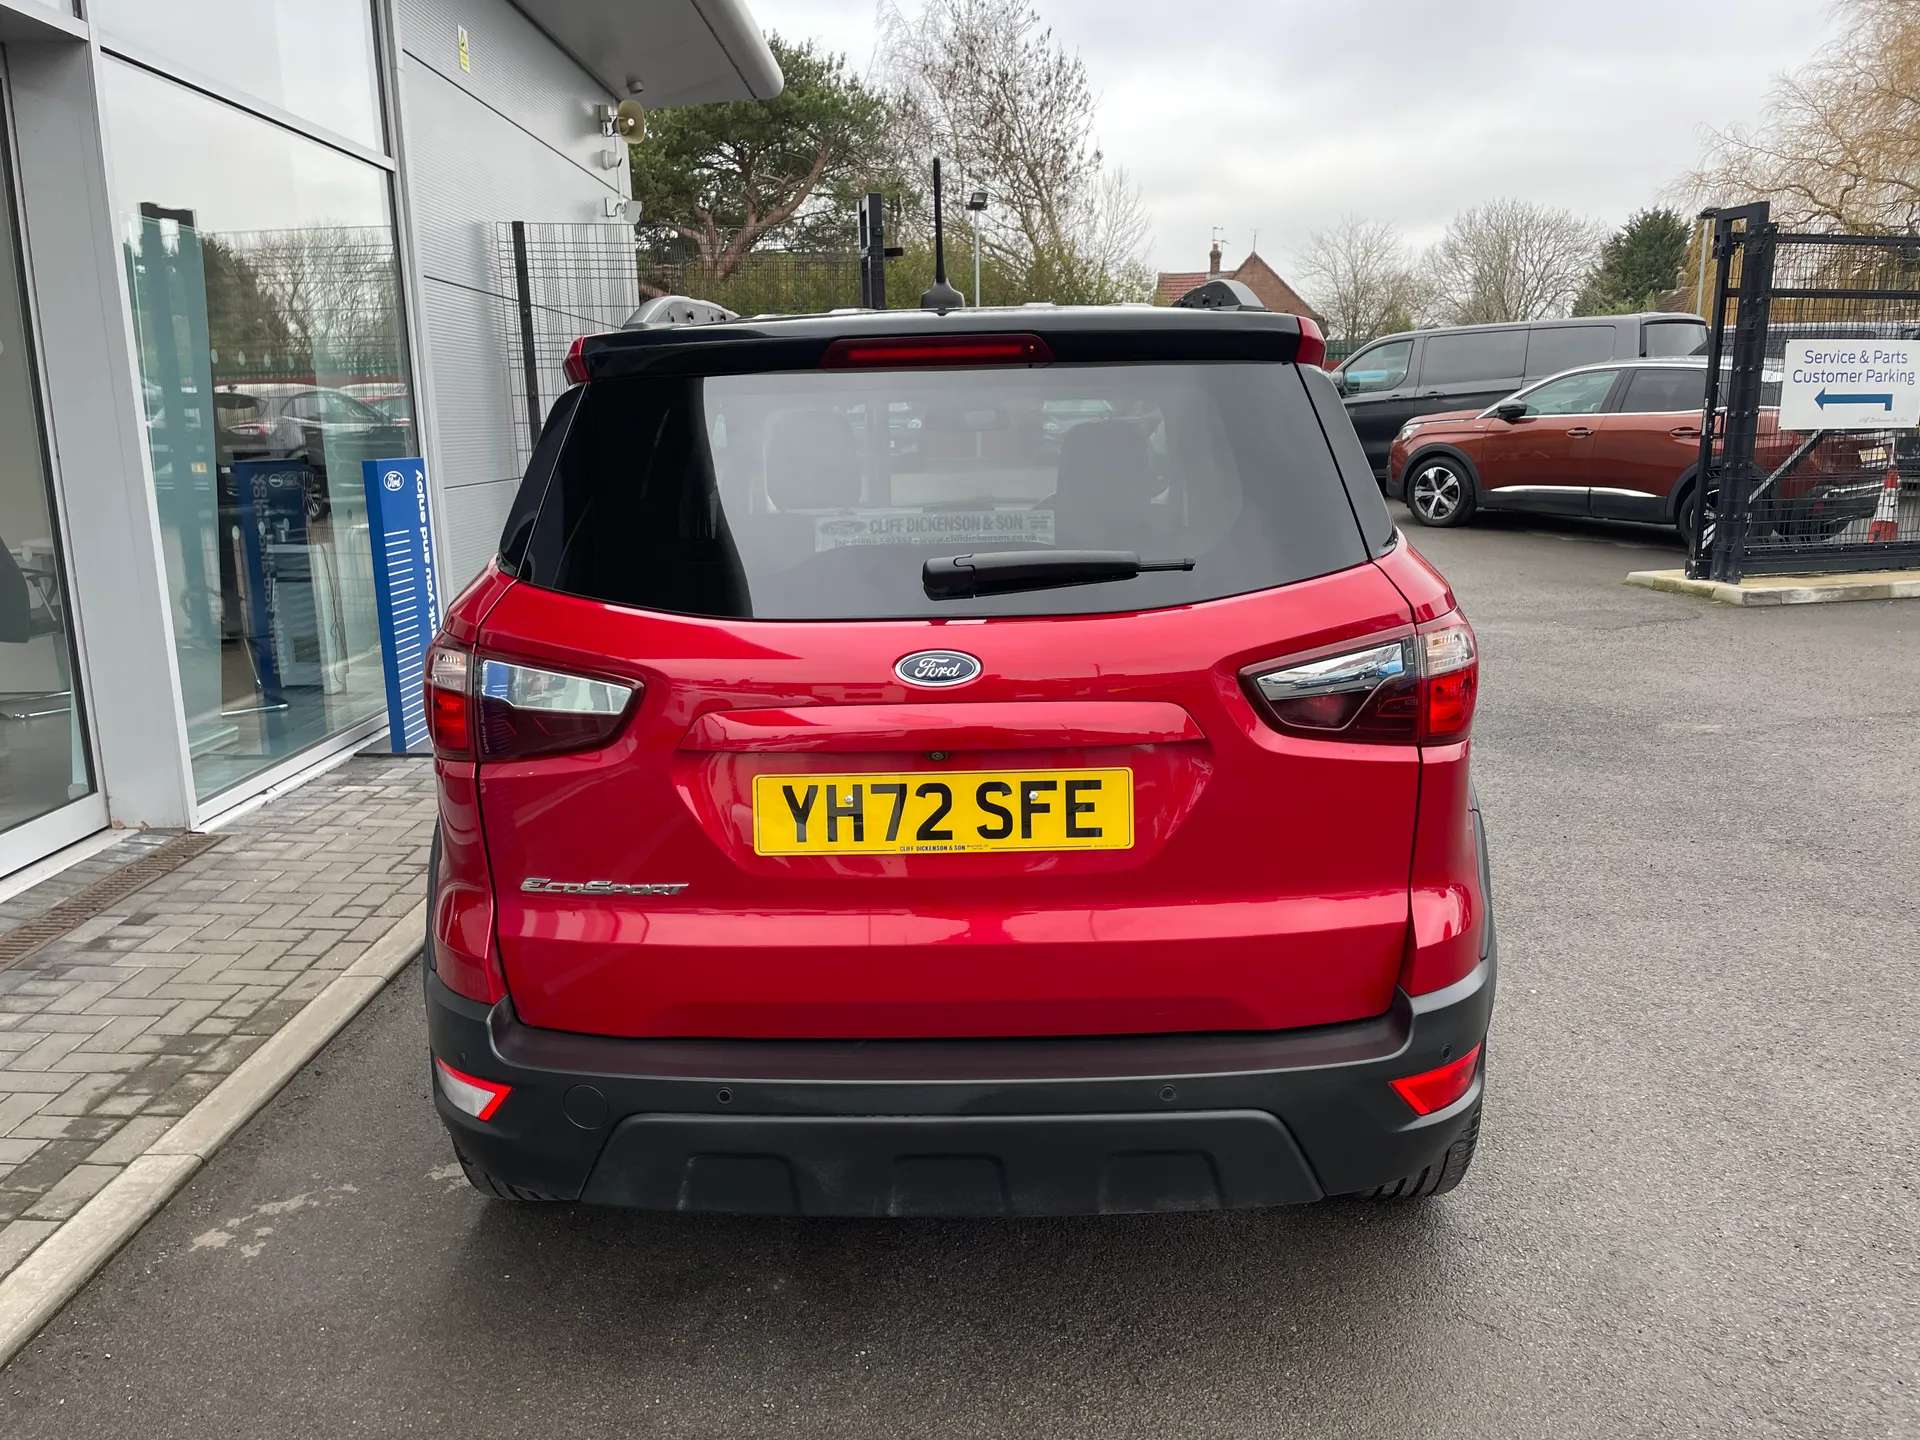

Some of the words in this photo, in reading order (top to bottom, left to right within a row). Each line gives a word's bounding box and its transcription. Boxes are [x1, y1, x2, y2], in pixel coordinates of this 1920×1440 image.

[1803, 350, 1856, 364] Service
[1860, 350, 1869, 364] &
[1873, 350, 1908, 364] Parts
[1792, 369, 1863, 384] Customer
[1866, 369, 1915, 386] Parking
[415, 469, 426, 524] enjoy
[869, 518, 905, 535] CLIFF
[906, 515, 980, 533] DICKENSON
[982, 515, 994, 531] &
[998, 514, 1023, 531] SON
[420, 526, 431, 565] and
[425, 567, 435, 604] you
[914, 658, 960, 678] Ford
[782, 782, 953, 843] YH72
[976, 779, 1103, 839] SFE
